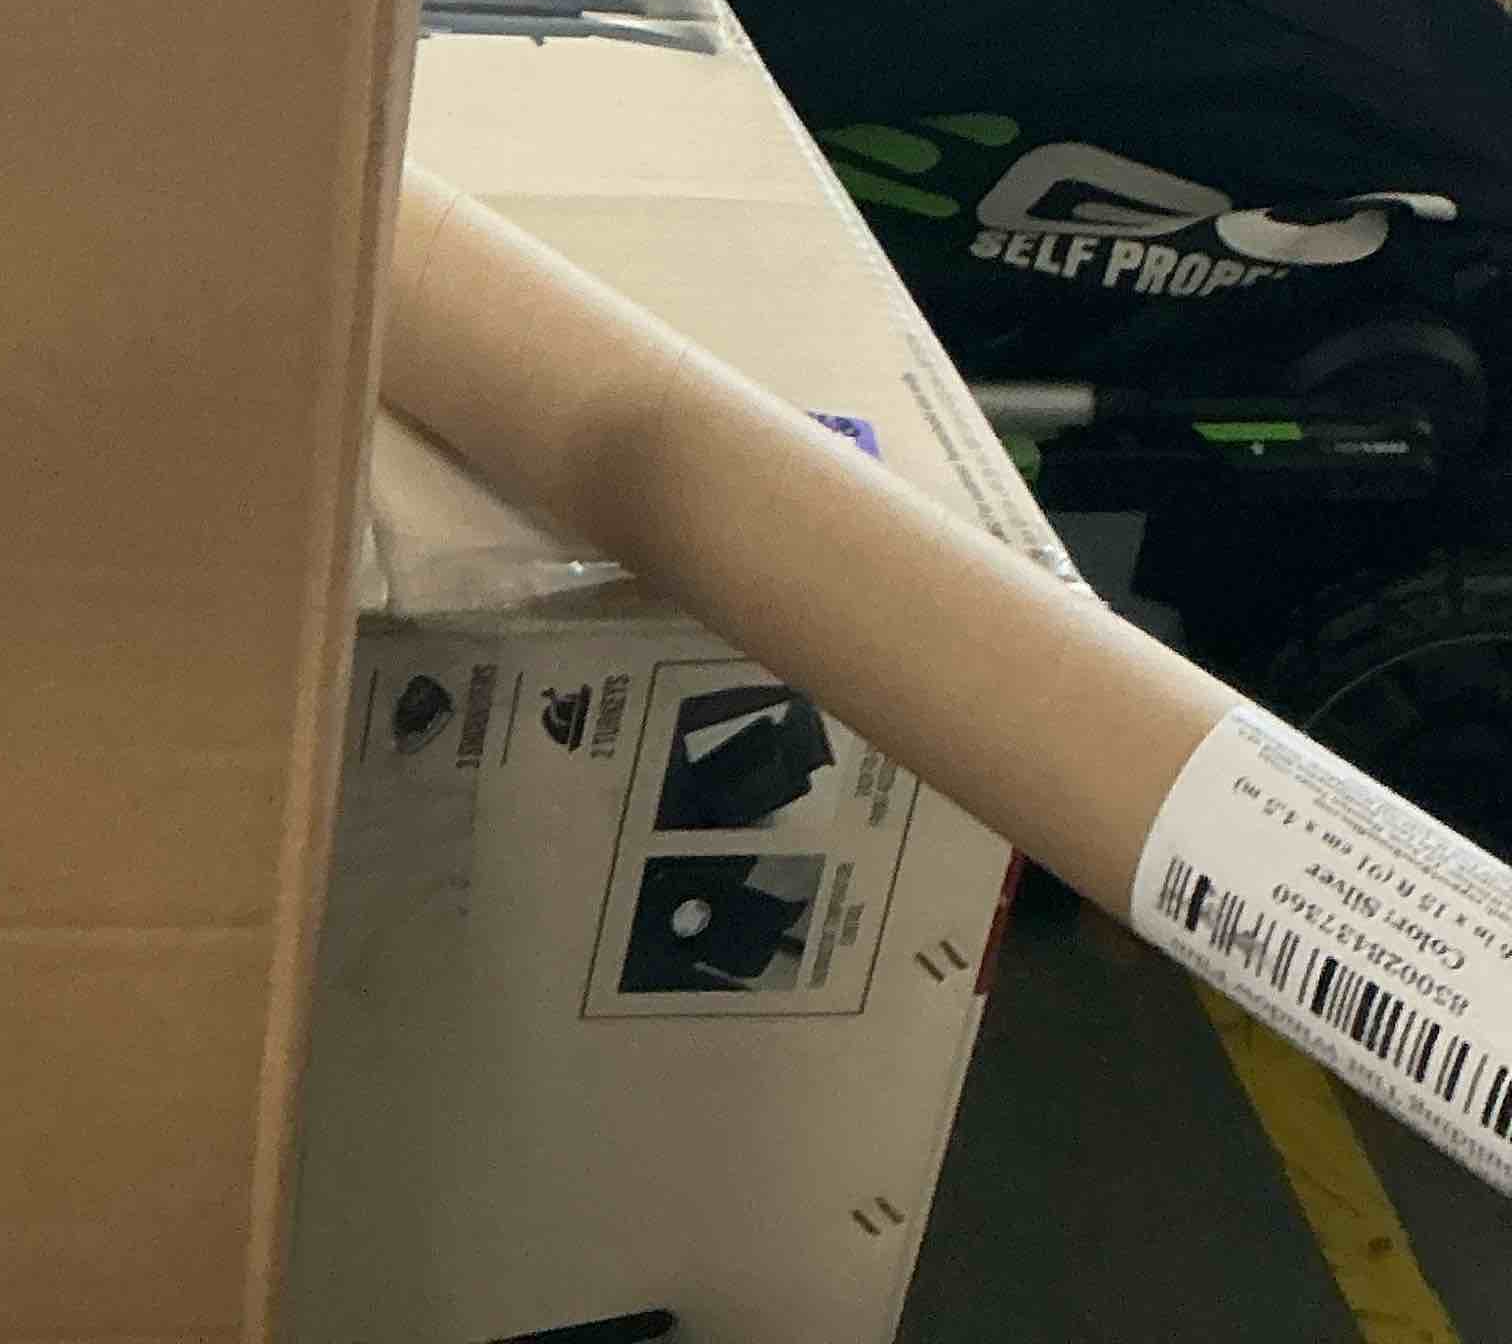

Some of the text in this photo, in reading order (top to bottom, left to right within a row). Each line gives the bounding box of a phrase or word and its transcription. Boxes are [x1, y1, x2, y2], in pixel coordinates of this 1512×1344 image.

[970, 231, 1289, 297] SELF PROP
[1305, 862, 1466, 970] Color: Silver
